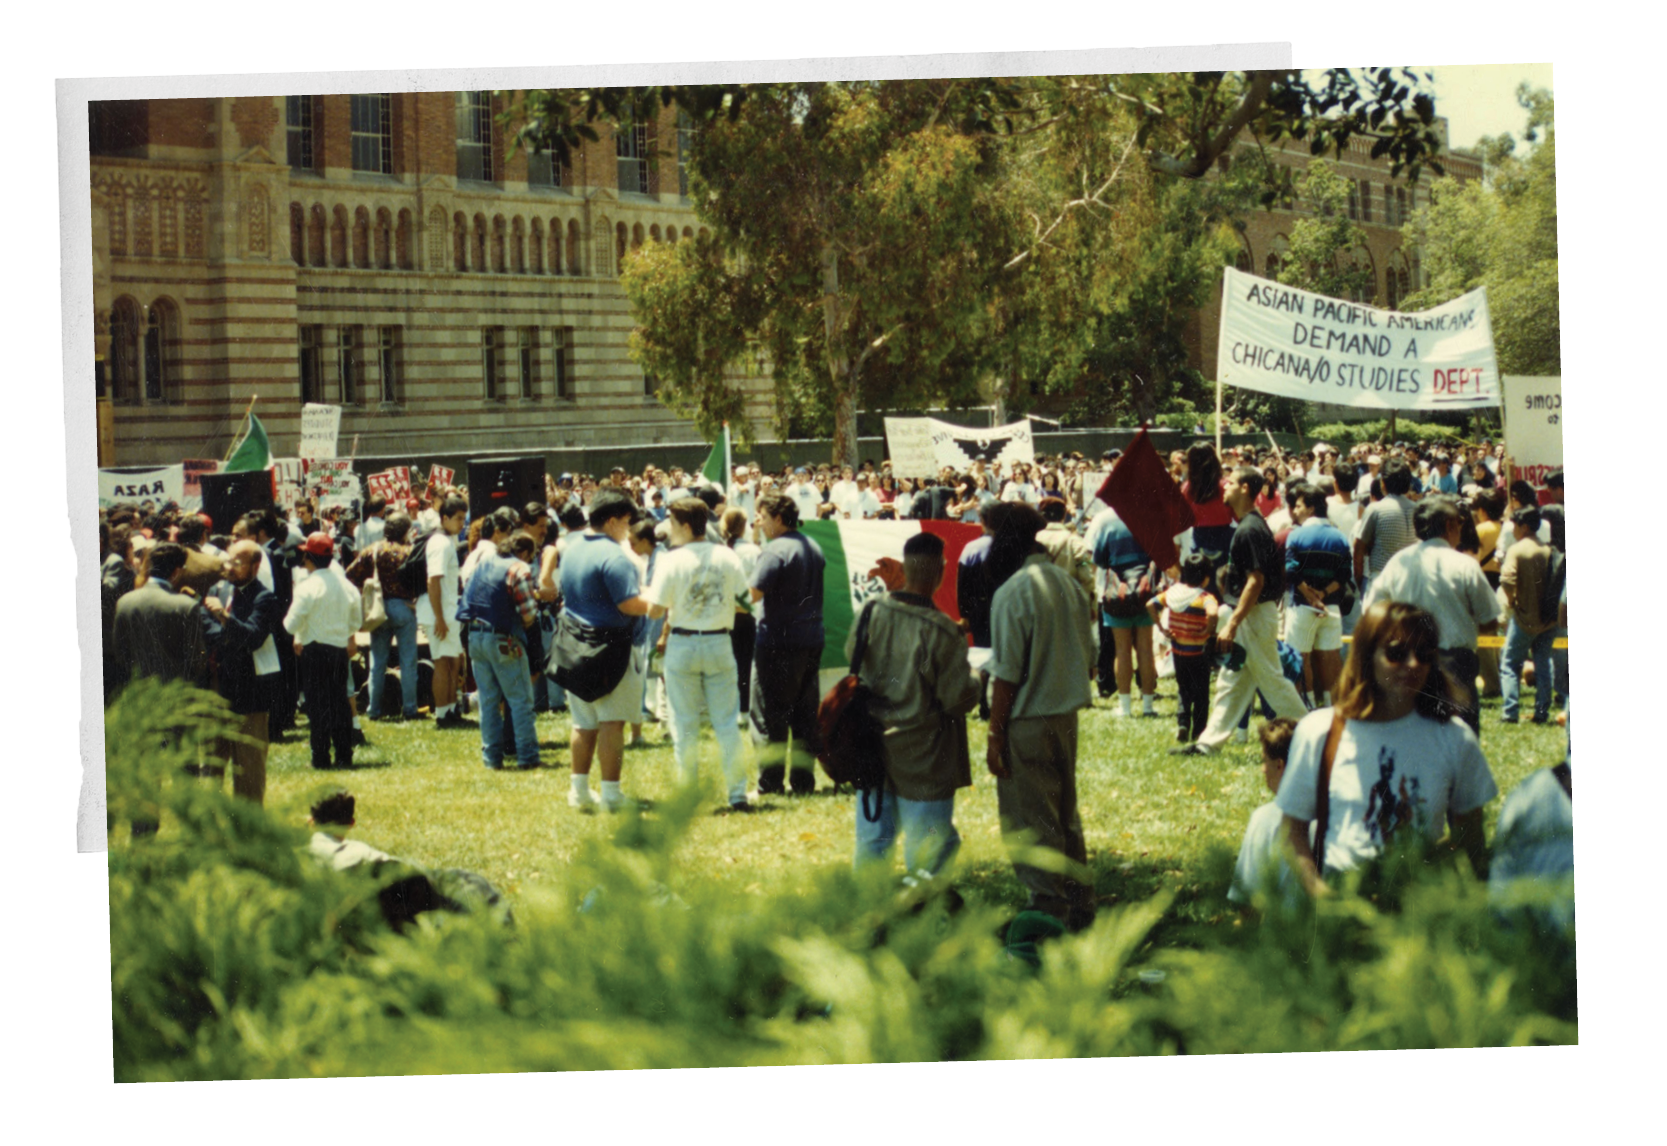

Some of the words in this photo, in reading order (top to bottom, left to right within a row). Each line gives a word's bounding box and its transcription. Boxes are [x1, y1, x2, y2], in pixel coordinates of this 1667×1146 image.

[1246, 283, 1304, 315] ASIAN
[1313, 298, 1378, 327] PACIFIC
[1387, 308, 1476, 331] AMERICANS
[1293, 321, 1392, 358] DEMAND
[1404, 337, 1418, 359] A
[1232, 342, 1331, 384] CHICANA/O
[1335, 363, 1420, 394] STUDIES
[1433, 367, 1490, 395] DEPT.
